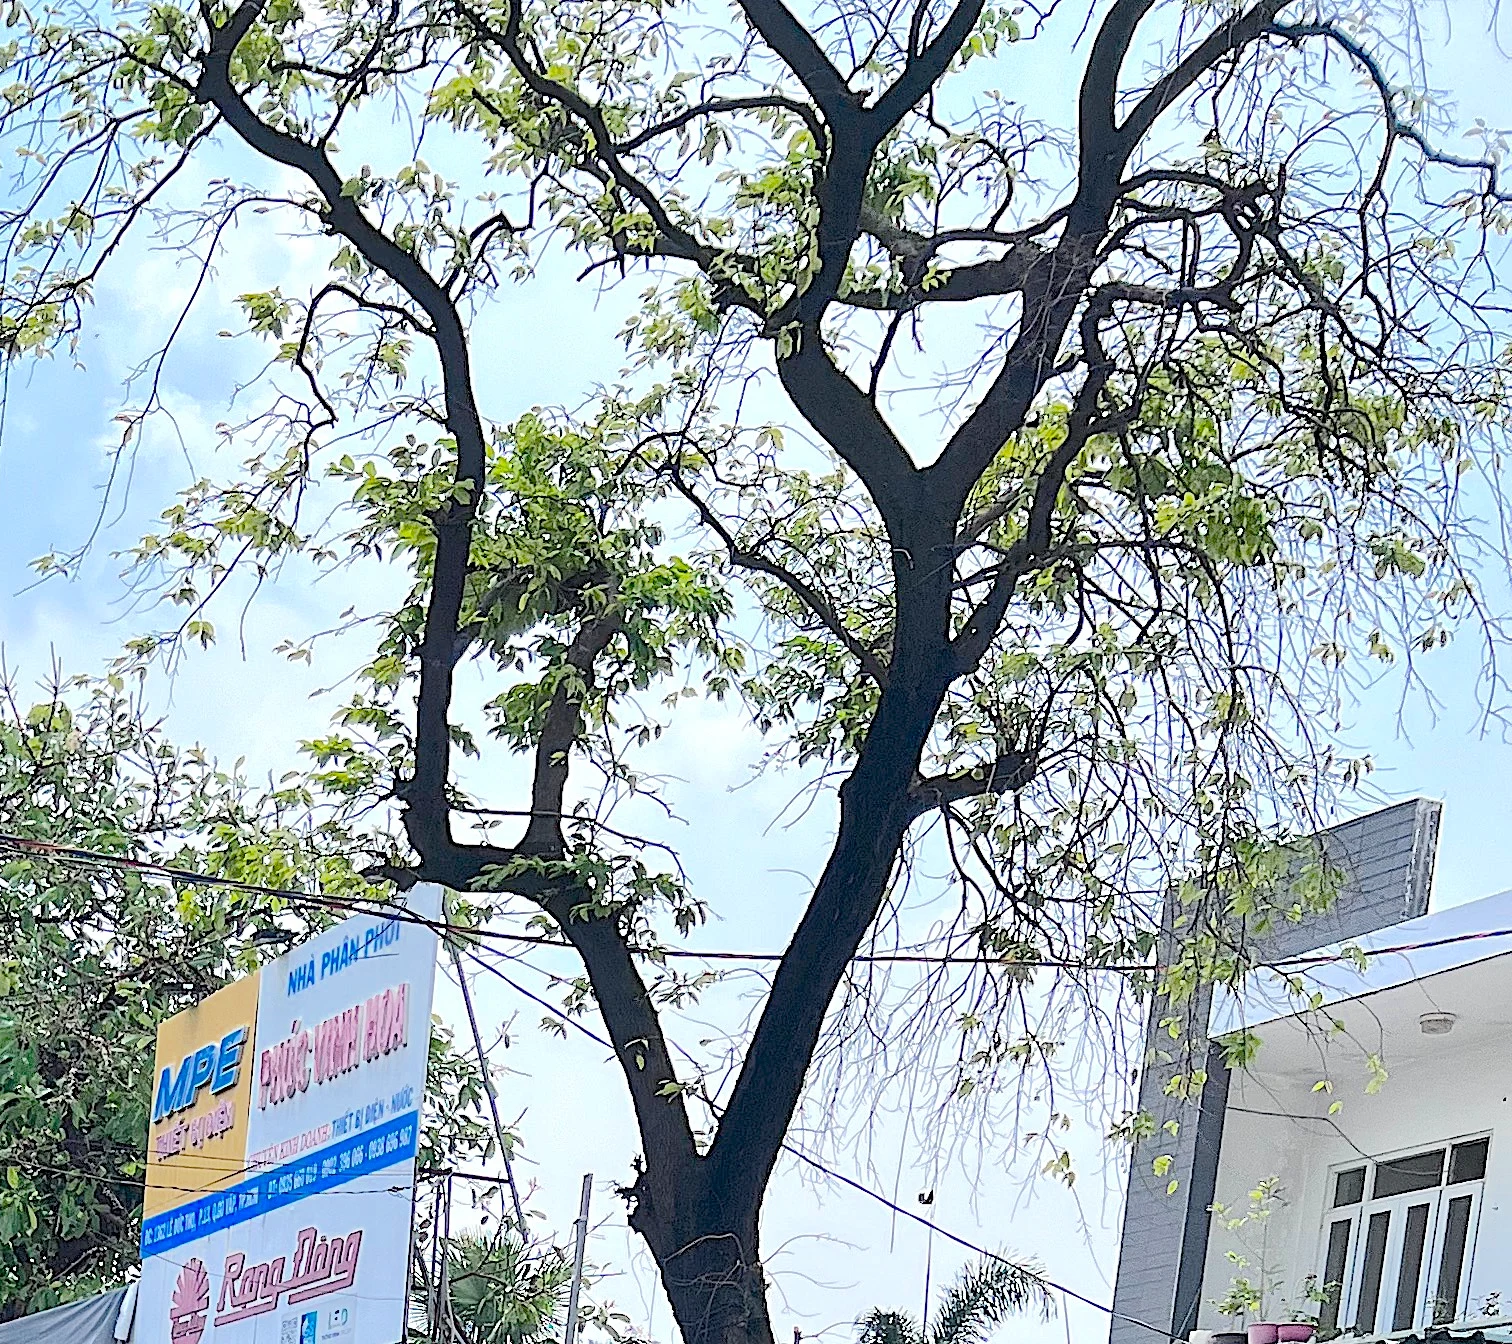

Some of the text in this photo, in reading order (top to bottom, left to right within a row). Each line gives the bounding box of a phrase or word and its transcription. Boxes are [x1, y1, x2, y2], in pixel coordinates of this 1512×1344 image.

[288, 953, 315, 998] NHÀ
[320, 935, 360, 981] PHÂN
[154, 1025, 248, 1125] MPE
